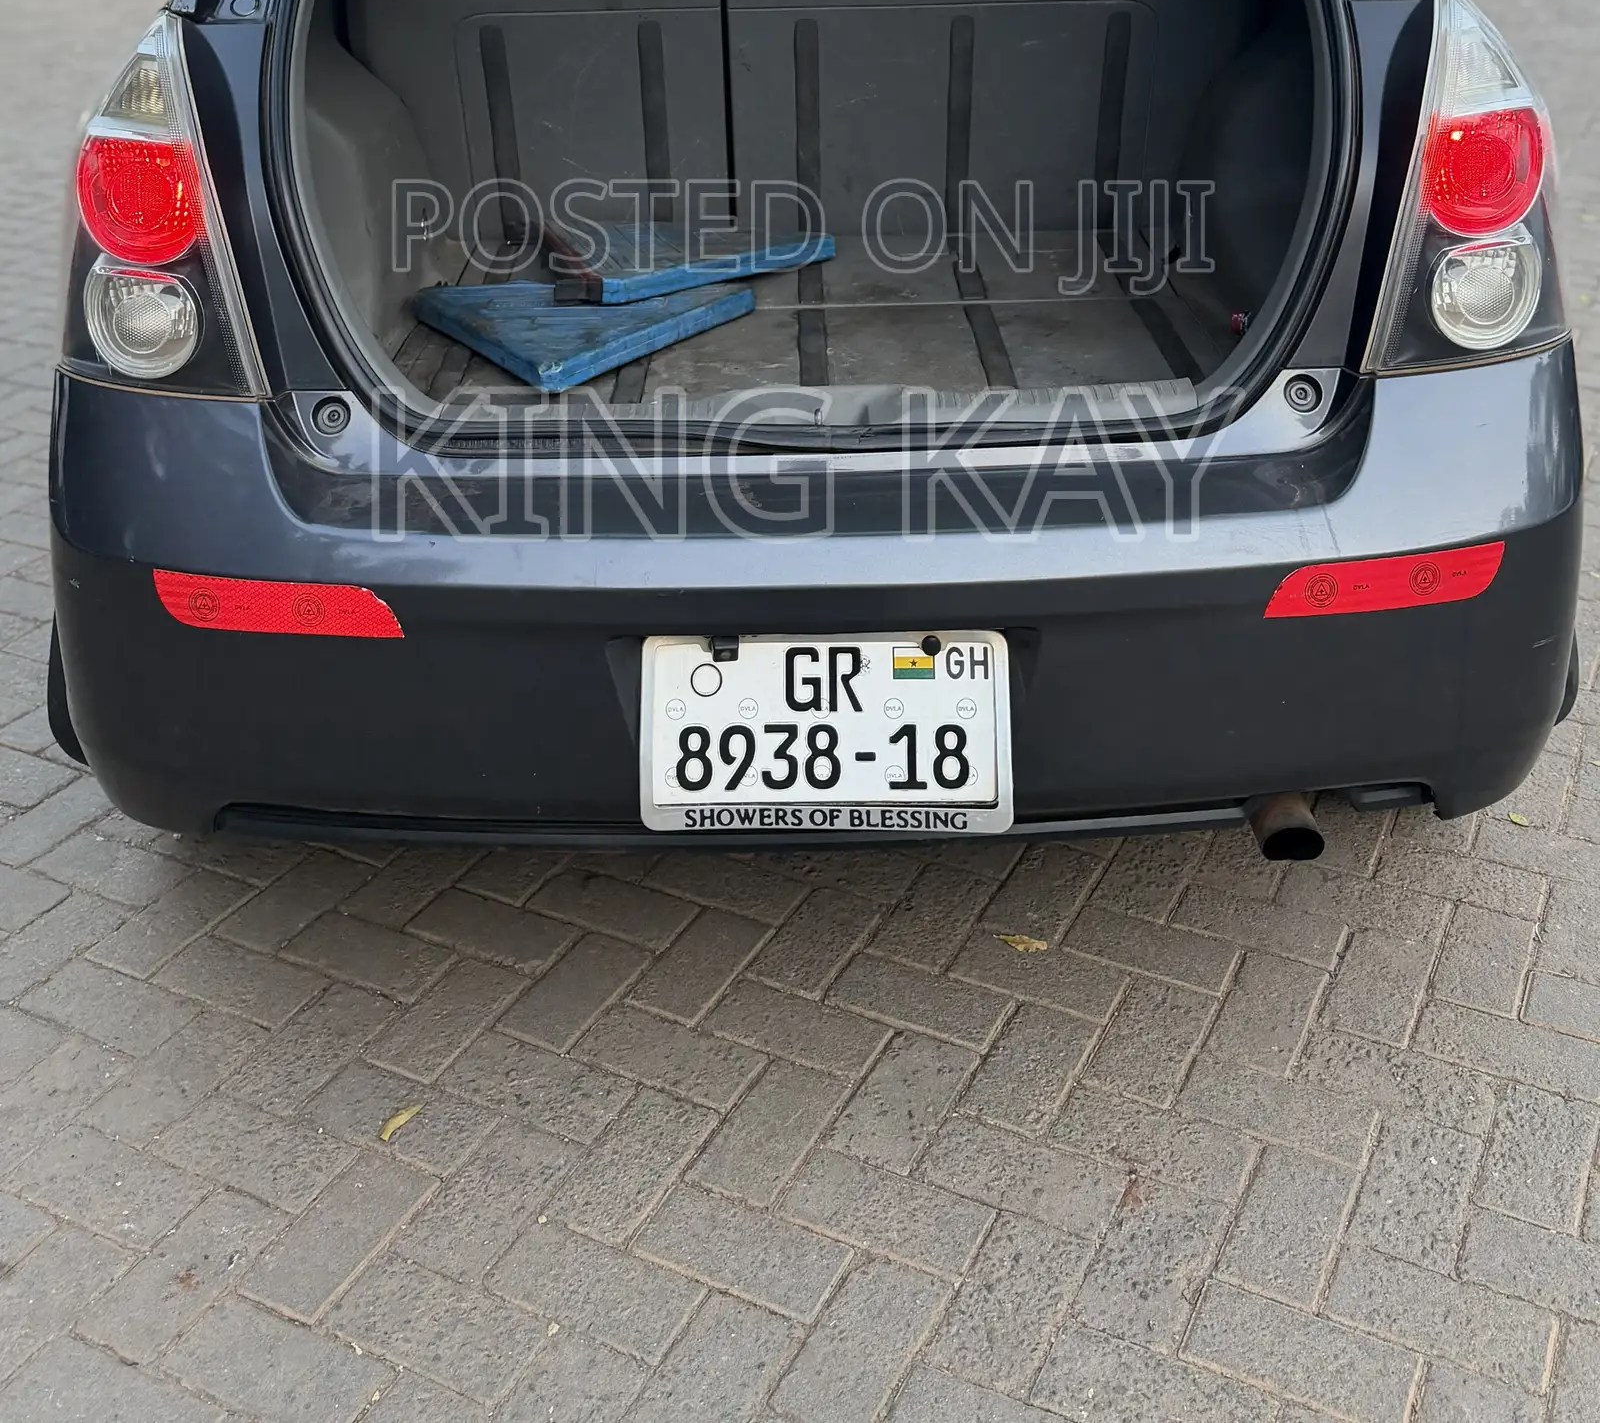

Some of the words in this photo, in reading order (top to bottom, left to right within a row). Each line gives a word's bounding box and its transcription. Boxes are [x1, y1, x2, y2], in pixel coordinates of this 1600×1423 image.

[785, 646, 863, 712] GR
[945, 646, 989, 680] GH
[676, 723, 969, 791] 8938-18
[684, 808, 803, 828] SHOWERS
[808, 808, 843, 828] OF
[849, 809, 969, 830] BLESSING
